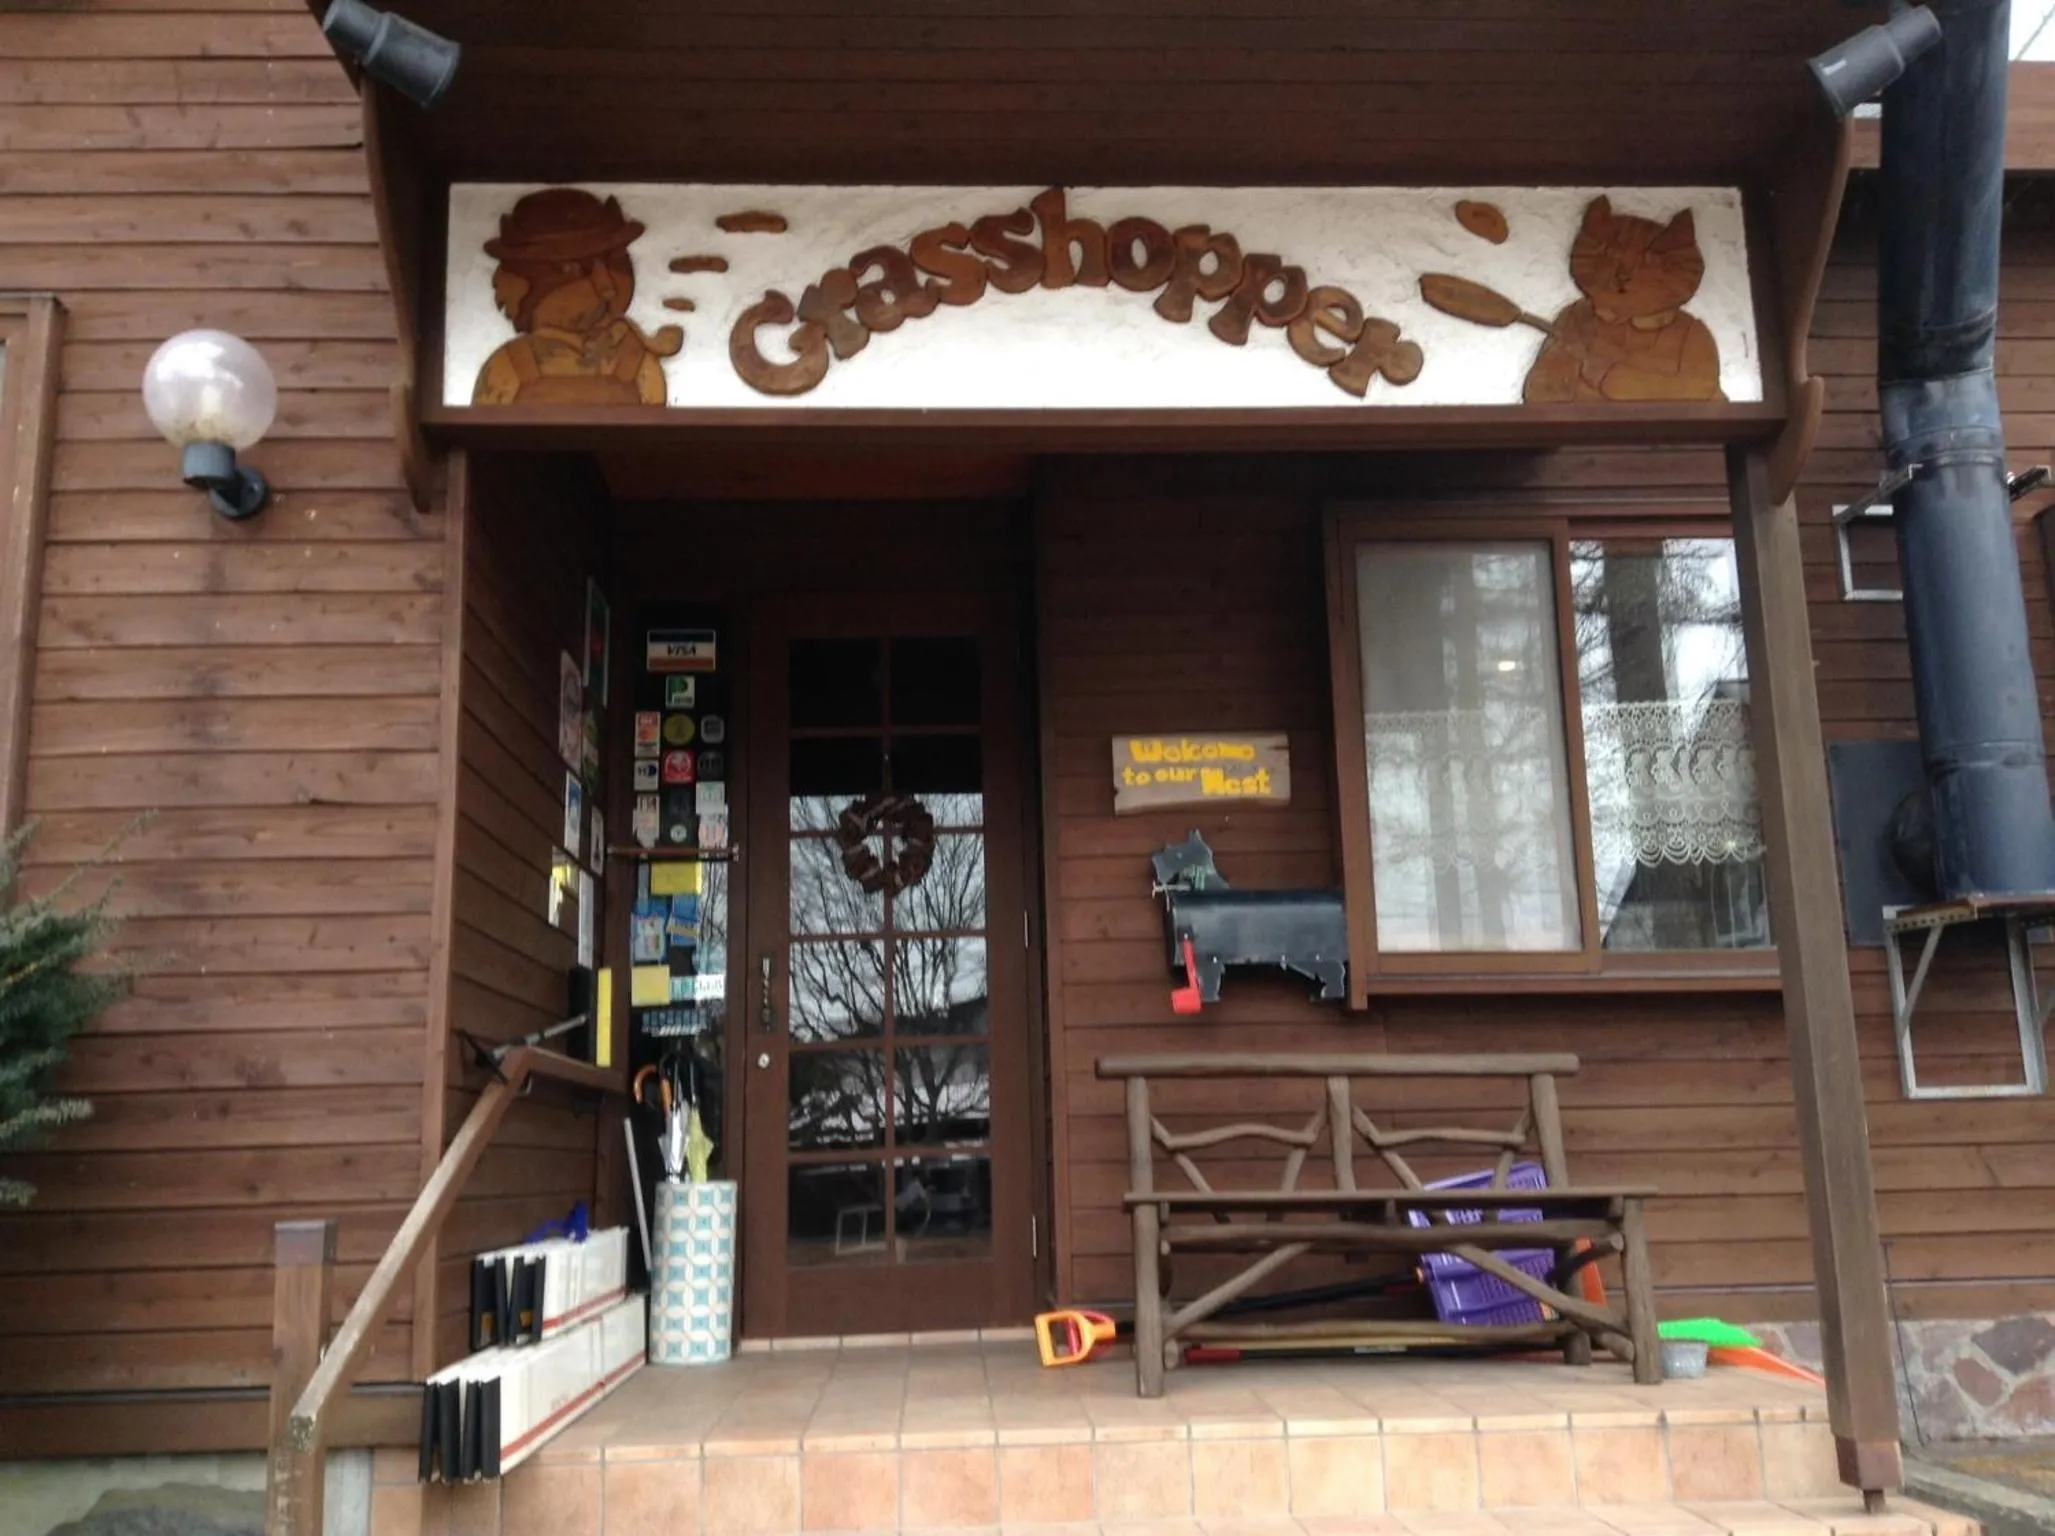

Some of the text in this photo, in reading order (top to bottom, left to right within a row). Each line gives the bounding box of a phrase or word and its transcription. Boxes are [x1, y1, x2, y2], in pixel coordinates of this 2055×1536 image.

[729, 185, 1424, 398] Grasshopper
[667, 643, 697, 656] VISA
[1129, 737, 1256, 763] Welcome
[1122, 766, 1151, 786] to
[1154, 767, 1197, 782] our
